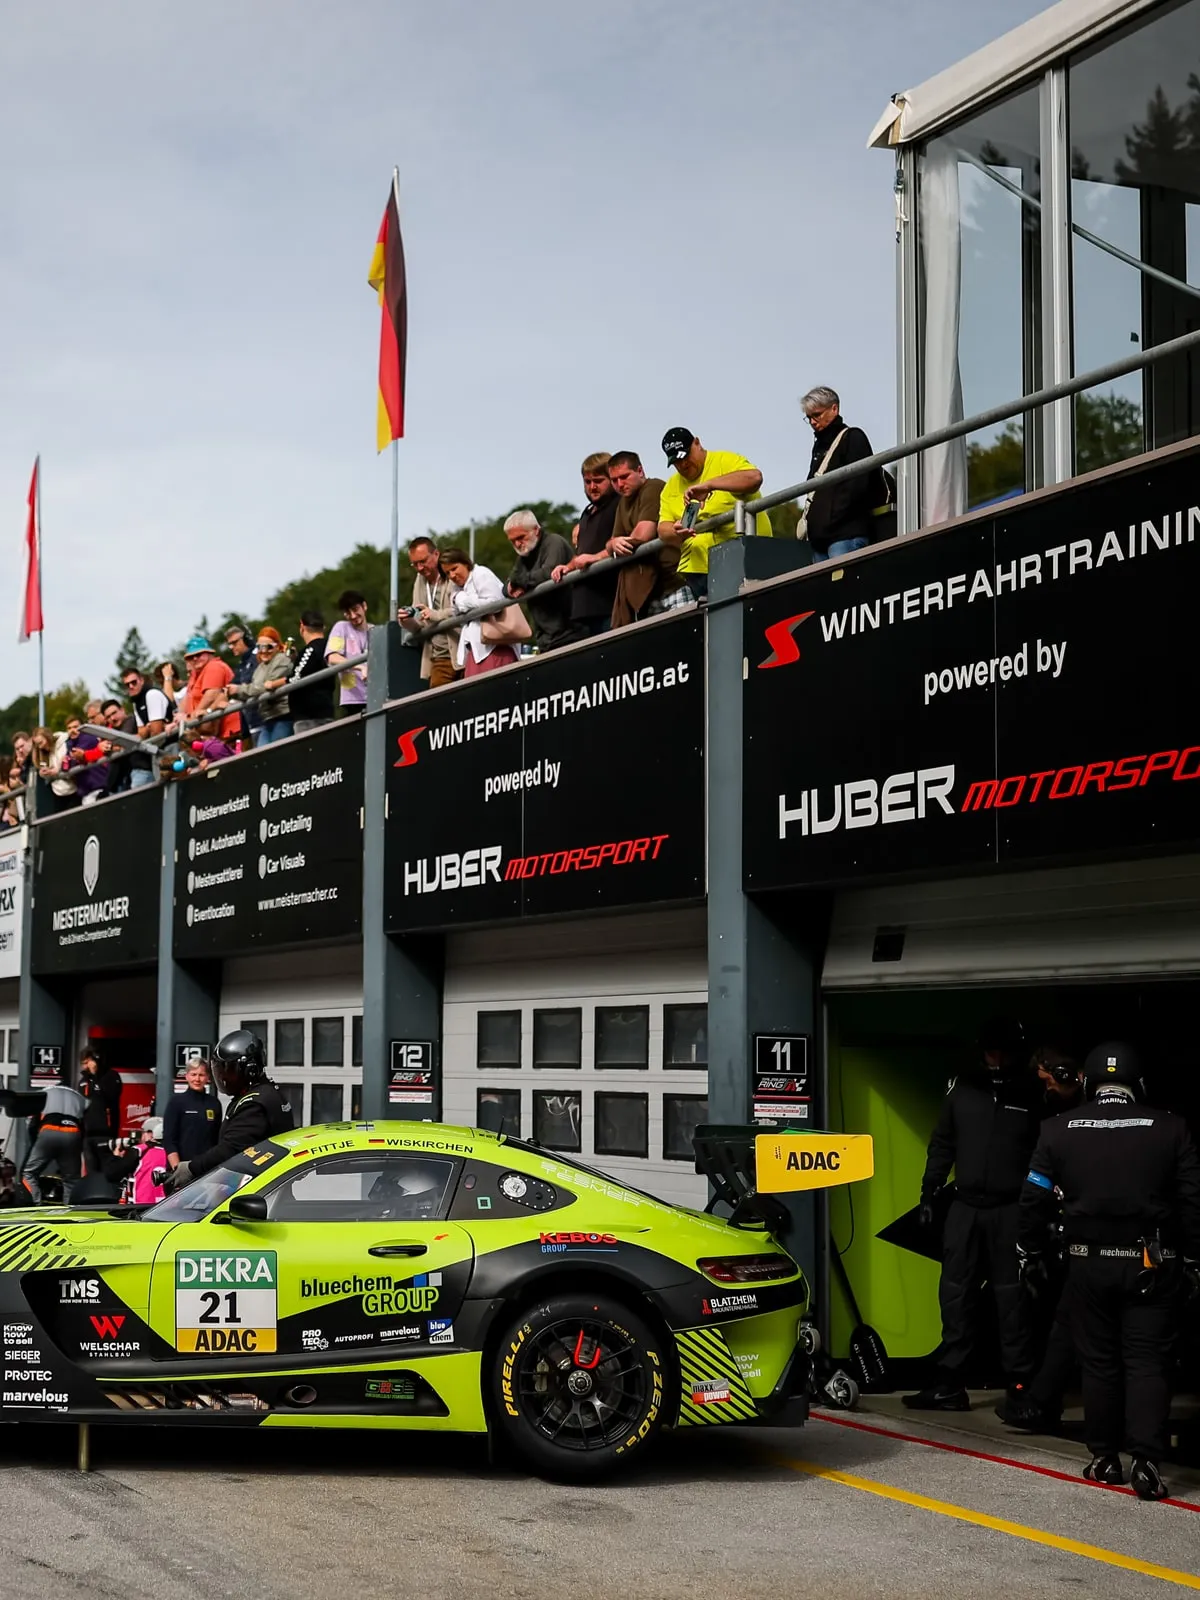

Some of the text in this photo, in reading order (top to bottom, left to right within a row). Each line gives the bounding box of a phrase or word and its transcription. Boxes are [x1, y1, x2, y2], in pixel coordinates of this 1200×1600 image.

[924, 639, 1067, 705] powered by
[429, 661, 689, 751] WINTERFAHRTRAINING.at
[268, 767, 343, 802] Car Storage Parkloft
[485, 758, 561, 802] powered by
[196, 794, 250, 823] Meisterwerkstatt
[779, 764, 955, 839] HUBER
[268, 814, 312, 837] Car Detailing
[267, 852, 305, 874] Car Visuals
[404, 835, 669, 896] HUBER MOTORSPORT
[258, 887, 338, 911] www.meistermacher.cc
[52, 896, 130, 931] MEISTERMACHER
[398, 1045, 423, 1068] 12
[770, 1041, 791, 1071] 11
[310, 1138, 474, 1155] FITTJE WISKIRCHEN
[786, 1151, 840, 1171] ADAC
[540, 1231, 618, 1245] KEBOS
[541, 1243, 567, 1253] GROUP
[179, 1256, 274, 1283] DEKRA
[59, 1279, 100, 1298] TMS
[301, 1274, 392, 1298] bluechem
[198, 1291, 242, 1324] 21
[363, 1286, 439, 1316] GROUP
[710, 1294, 757, 1308] BLATZHEIM
[3, 1324, 33, 1332] Know
[302, 1329, 321, 1338] PRO
[380, 1325, 420, 1338] marvelous
[430, 1321, 446, 1330] blue
[80, 1342, 140, 1351] WELSCHAR
[195, 1329, 257, 1352] ADAC
[334, 1333, 374, 1343] AUTOPROFI
[4, 1350, 41, 1360] SIEGER
[4, 1370, 52, 1381] PROTEC
[502, 1330, 526, 1417] PIRELLI
[2, 1388, 69, 1403] marvelous
[637, 1350, 663, 1439] P ZERO
[692, 1383, 714, 1393] maxx
[703, 1389, 730, 1402] power
